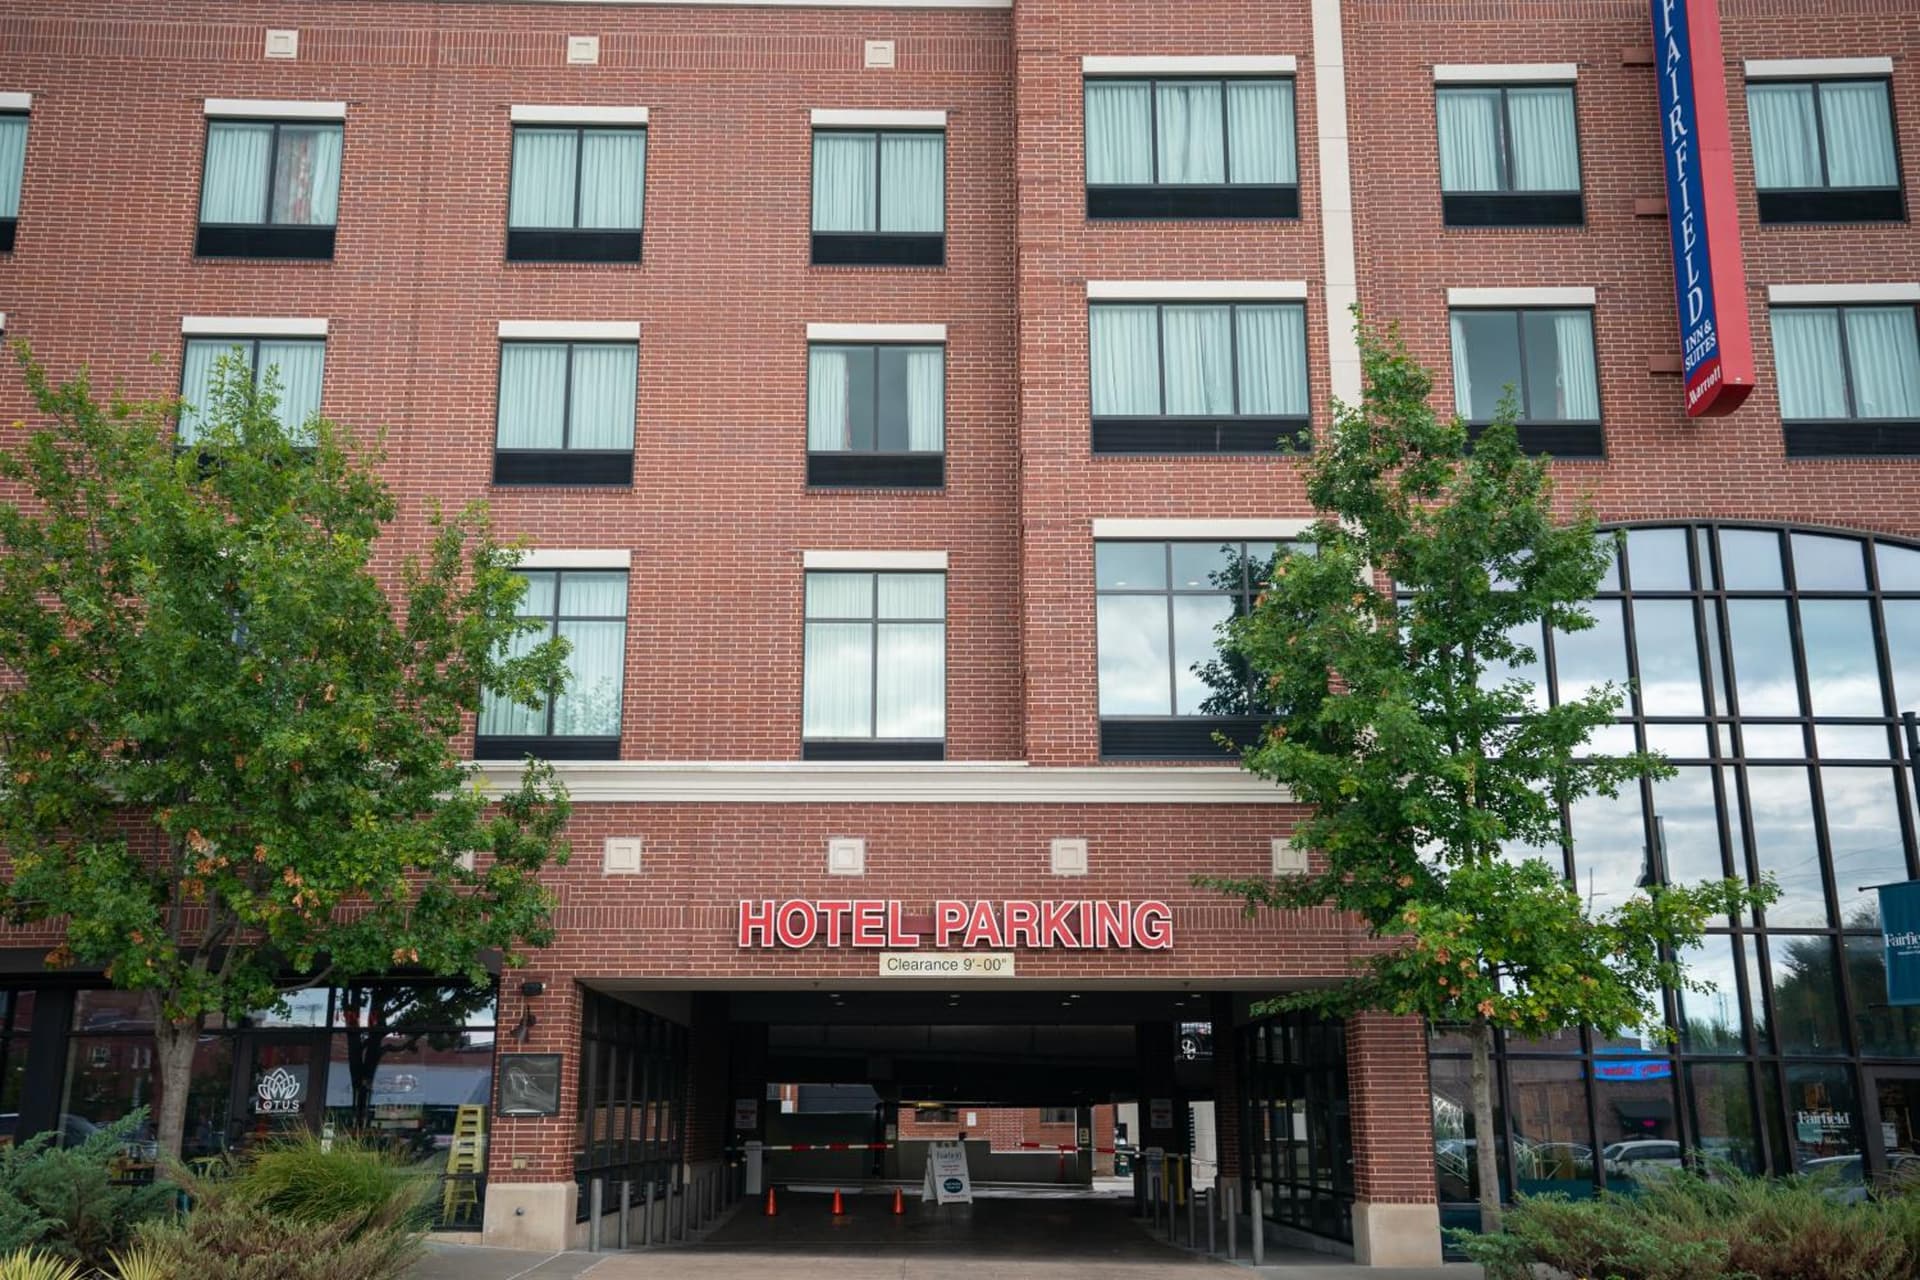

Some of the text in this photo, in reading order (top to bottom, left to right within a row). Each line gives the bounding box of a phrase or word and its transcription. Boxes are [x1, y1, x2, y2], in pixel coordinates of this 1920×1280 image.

[1662, 0, 1704, 327] FAIRFIELD
[1685, 319, 1712, 353] INN &
[1685, 331, 1717, 372] SUITES
[1688, 365, 1721, 410] Marriott
[738, 899, 1174, 949] HOTEL PARKING
[887, 957, 959, 972] Clearance
[255, 1099, 300, 1111] LOTUS
[1798, 1111, 1850, 1125] Fairfield
